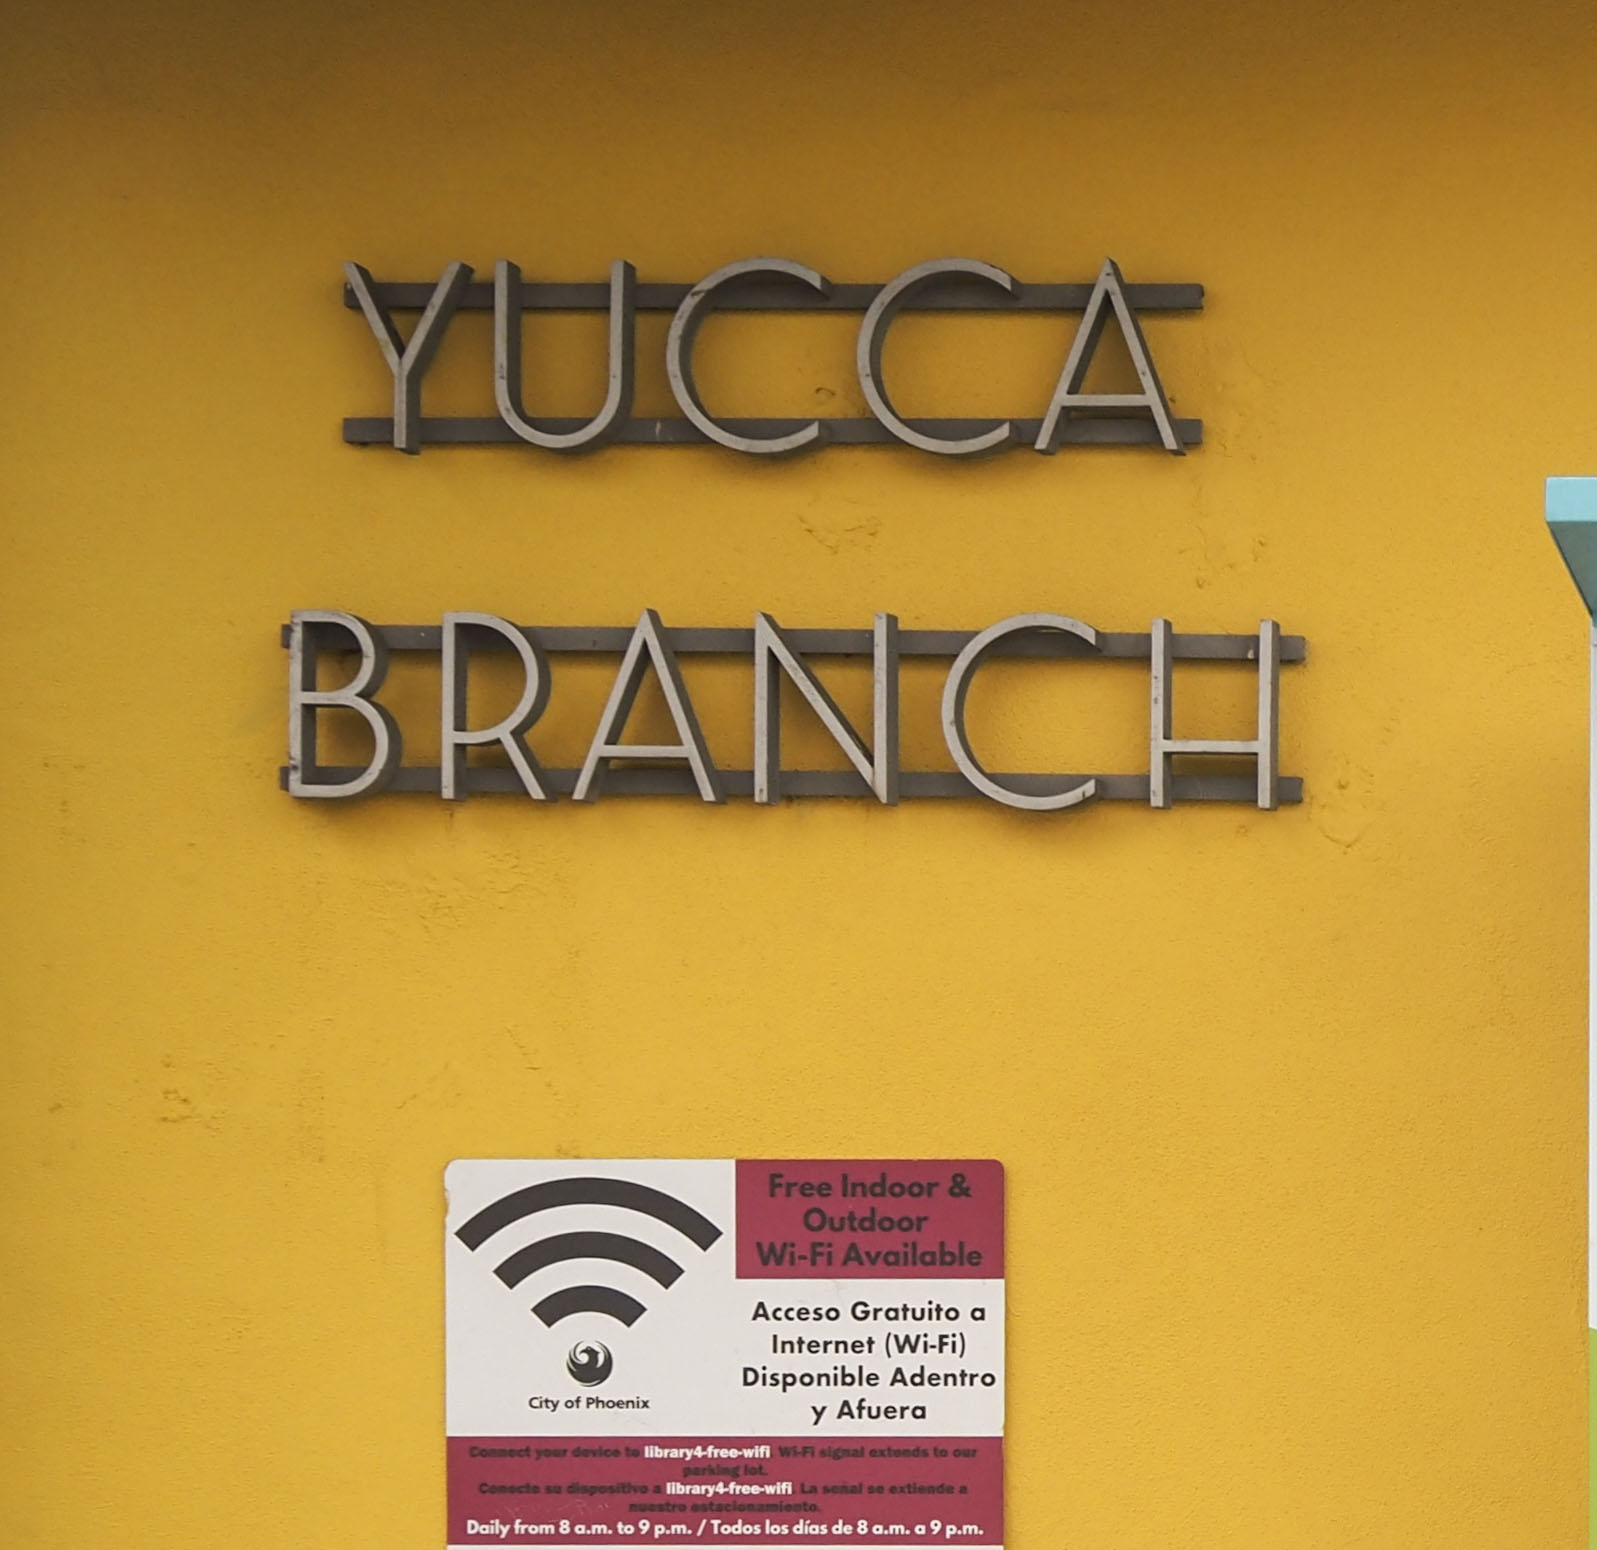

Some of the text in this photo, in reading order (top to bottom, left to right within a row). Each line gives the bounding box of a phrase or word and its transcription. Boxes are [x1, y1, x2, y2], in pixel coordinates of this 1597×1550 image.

[344, 257, 1187, 455] YUCCA
[289, 608, 1281, 811] BRANCH
[768, 1172, 971, 1199] Free Indoor &
[803, 1207, 928, 1234] Outdoor
[756, 1241, 983, 1268] Wi-Fi Available
[751, 1301, 986, 1323] Acceso Gratuito a
[772, 1333, 966, 1359] Internet (Wi-Fi)
[742, 1366, 996, 1393] Disponible Adentro
[528, 1396, 650, 1414] City of Phoenix
[811, 1399, 927, 1427] y Afuera
[469, 1446, 531, 1458] Connect
[535, 1448, 568, 1461] your
[572, 1446, 620, 1458] device
[625, 1447, 640, 1458] to
[778, 1446, 815, 1458] Wi-Fi
[820, 1446, 865, 1460] signal
[869, 1446, 929, 1458] extends
[933, 1447, 948, 1458] to
[953, 1448, 978, 1458] our
[683, 1464, 740, 1478] parking
[479, 1483, 541, 1494] Conecte
[545, 1485, 562, 1494] su
[567, 1482, 648, 1497] dispositivo
[652, 1485, 663, 1494] a
[801, 1483, 818, 1494] La
[867, 1485, 885, 1494] se
[889, 1482, 955, 1494] extiende
[959, 1485, 969, 1494] a
[629, 1502, 687, 1513] nuestro
[466, 1519, 511, 1539] Daily
[513, 1519, 555, 1535] from
[559, 1519, 571, 1535] 8
[574, 1523, 613, 1535] a.m.
[616, 1520, 635, 1535] to
[638, 1519, 651, 1535] 9
[654, 1523, 693, 1539] p.m.
[711, 1519, 761, 1535] Todos
[765, 1519, 789, 1535] los
[792, 1519, 828, 1535] días
[831, 1519, 853, 1535] de
[857, 1519, 868, 1535] 8
[872, 1523, 910, 1535] a.m.
[914, 1523, 926, 1535] a
[930, 1519, 942, 1535] 9
[945, 1523, 984, 1539] p.m.
